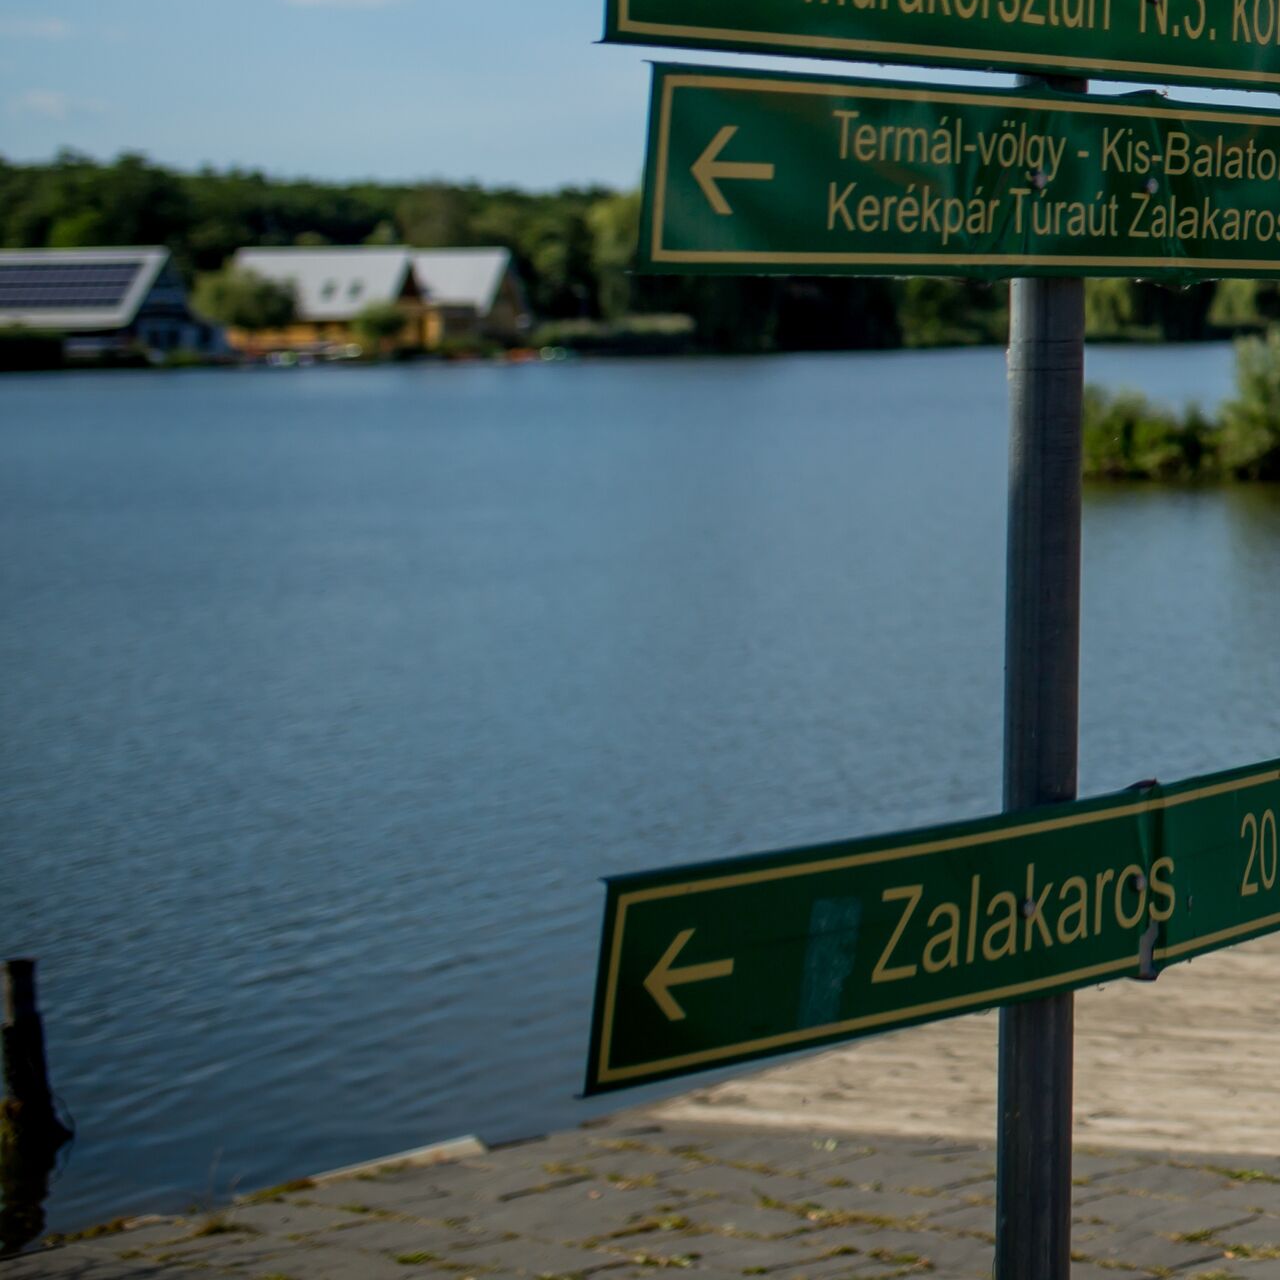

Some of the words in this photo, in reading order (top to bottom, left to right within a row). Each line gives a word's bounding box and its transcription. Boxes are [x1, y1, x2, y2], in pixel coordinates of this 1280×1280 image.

[832, 110, 1066, 182] Termál-völgy
[828, 183, 999, 244] Kerékpár
[1010, 188, 1117, 236] Túraút
[871, 856, 1176, 984] Zalakaros
